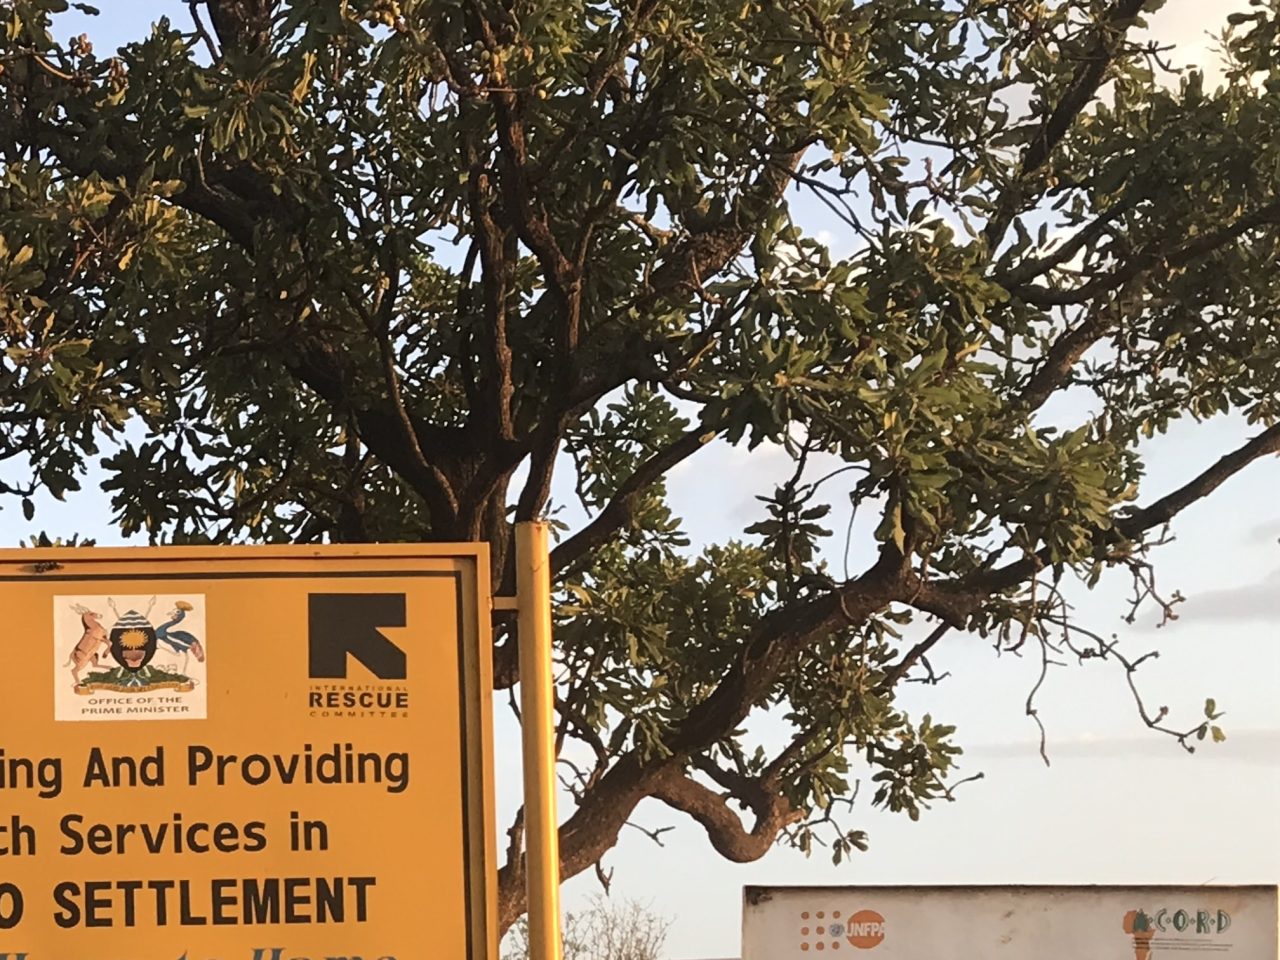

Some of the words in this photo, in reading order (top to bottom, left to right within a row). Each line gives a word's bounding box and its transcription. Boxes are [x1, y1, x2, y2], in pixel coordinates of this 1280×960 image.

[87, 696, 133, 706] OFFICE
[135, 695, 154, 704] OF
[157, 695, 183, 704] THE
[308, 691, 409, 709] RESCUE
[80, 706, 123, 715] PRIME
[125, 704, 190, 714] MINISTER
[308, 710, 409, 719] COMMITTEE
[82, 745, 165, 788] And
[187, 742, 409, 794] Providing
[59, 812, 267, 856] Services
[290, 810, 329, 852] in
[53, 876, 377, 929] SETTLEMENT
